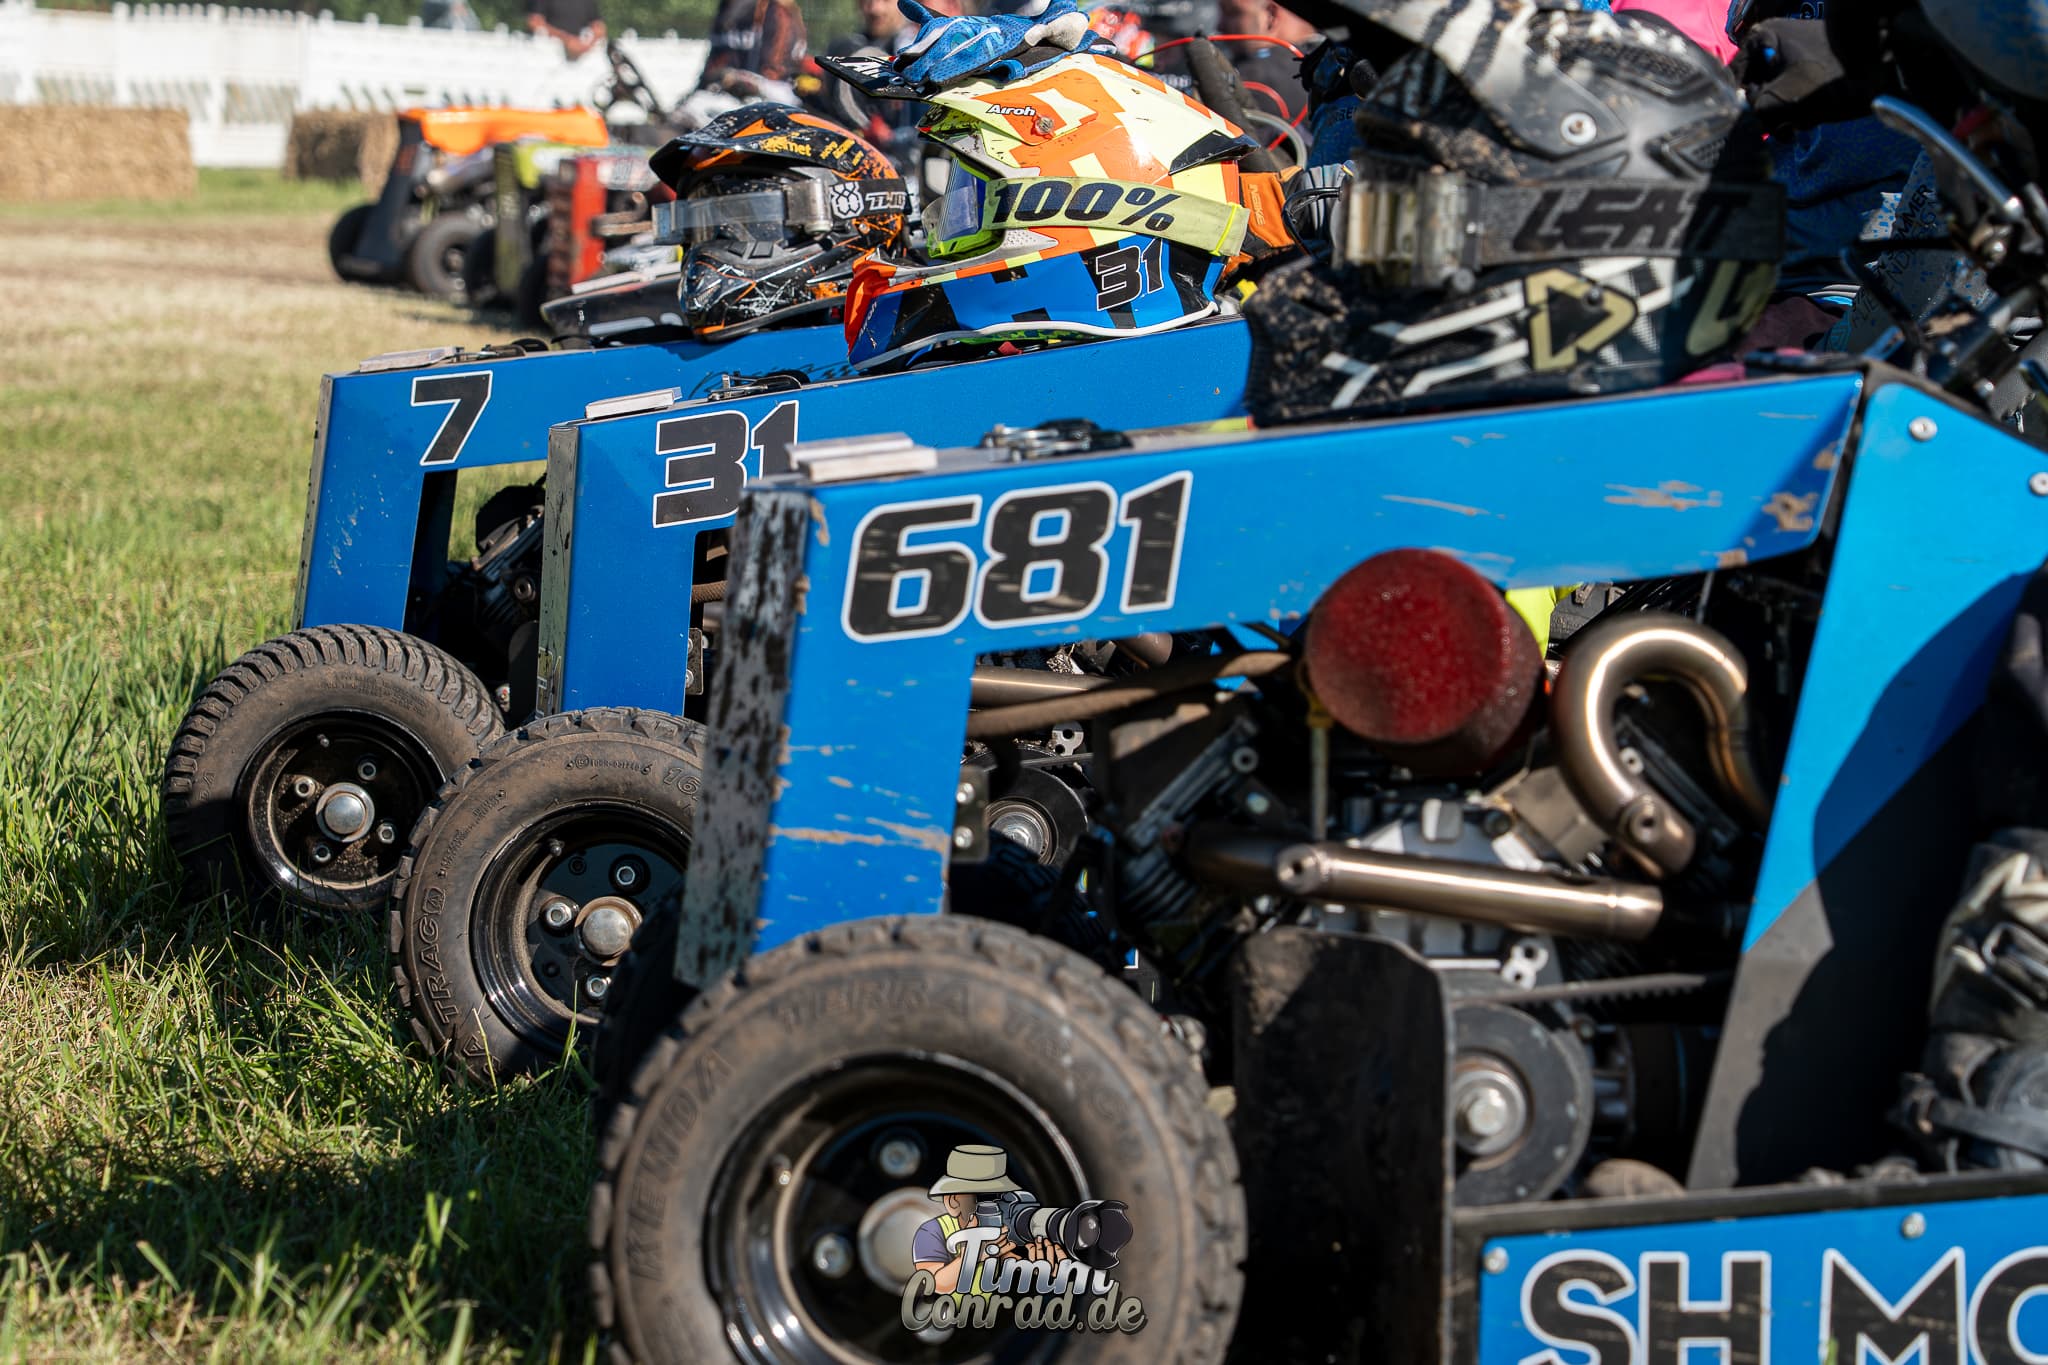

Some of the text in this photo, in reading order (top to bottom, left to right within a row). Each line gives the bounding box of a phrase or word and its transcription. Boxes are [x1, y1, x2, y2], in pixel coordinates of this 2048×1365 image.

[987, 103, 1036, 117] Airoh
[991, 179, 1182, 232] 100%
[1512, 187, 1752, 251] LEATT
[1096, 238, 1165, 312] 31
[411, 370, 493, 466] 7
[653, 400, 799, 529] 31
[841, 470, 1193, 644] 681
[628, 1048, 733, 1283] KENDA
[1519, 1248, 1772, 1365] SH
